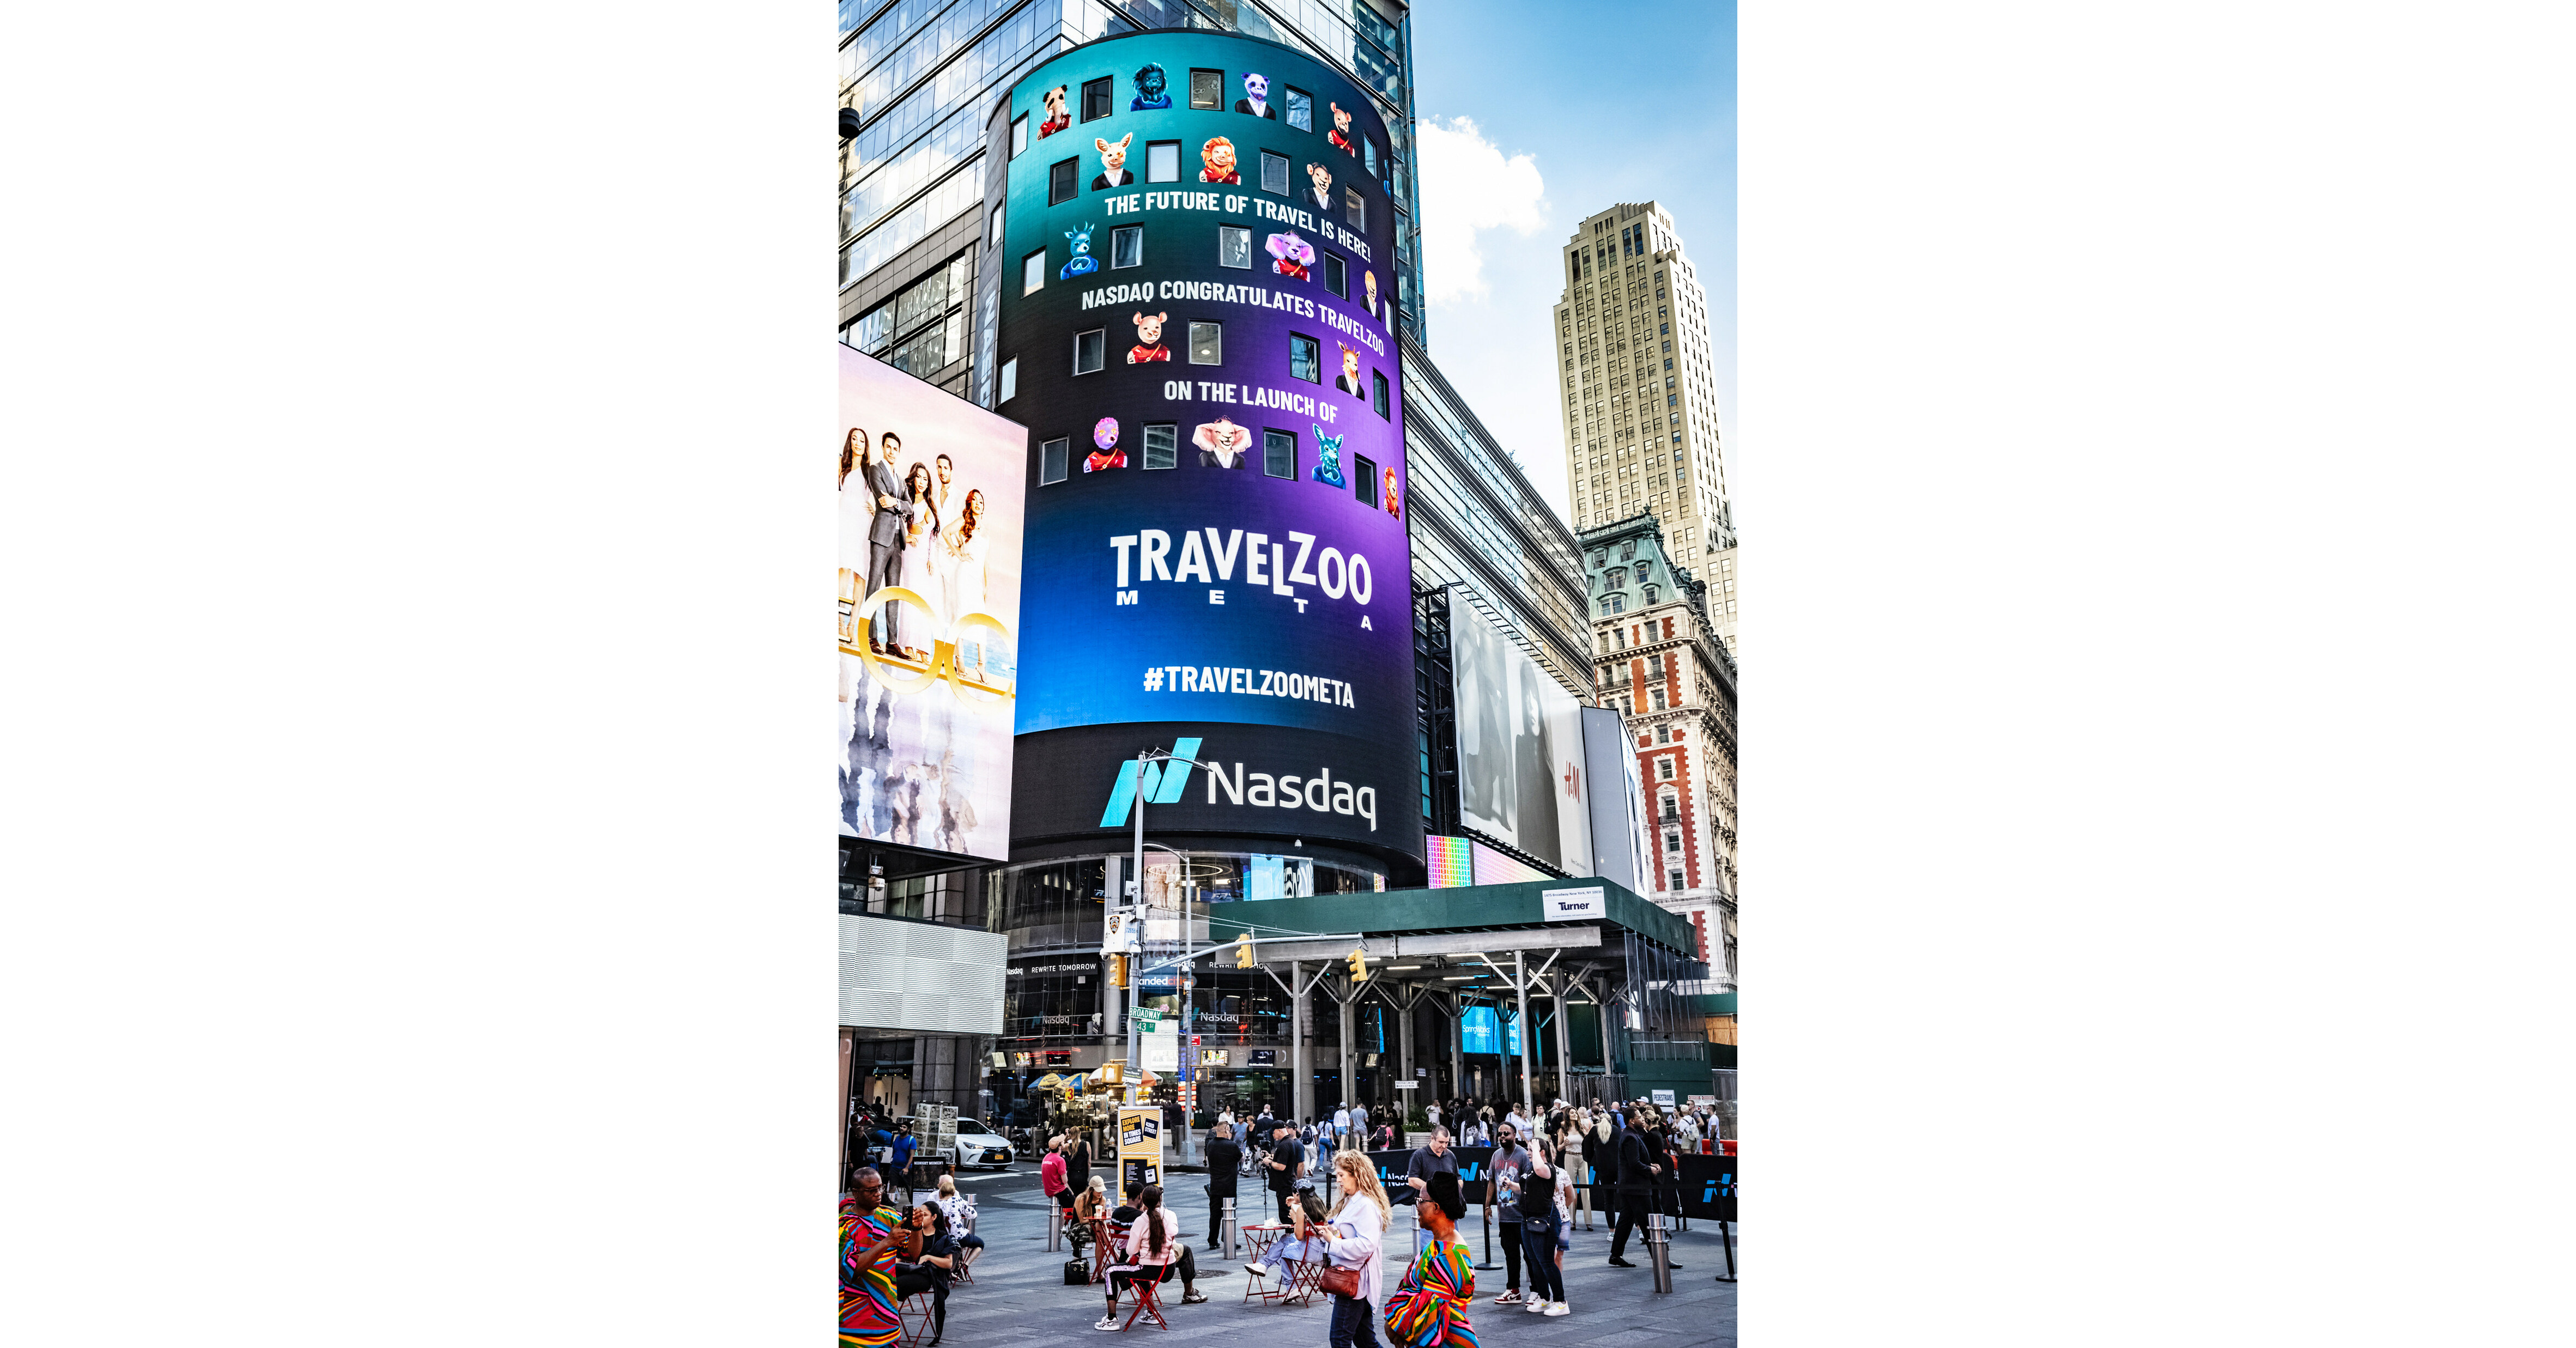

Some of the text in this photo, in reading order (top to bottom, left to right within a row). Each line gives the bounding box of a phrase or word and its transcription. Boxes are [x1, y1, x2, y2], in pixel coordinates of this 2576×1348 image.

[1105, 192, 1371, 264] THE FUTURE OF TRAVEL IS HERE!
[1082, 281, 1384, 357] NASDAQ CONGRATULATES TRAVELZOO
[979, 289, 996, 409] NASD
[1165, 380, 1338, 424] ON THE LAUNCH OF
[1110, 527, 1372, 605] TRAVELZOO
[1143, 666, 1355, 709] #TRAVELZOOMETA
[1564, 760, 1580, 804] H&M
[1207, 761, 1376, 832] Nasdaq
[1558, 902, 1590, 911] Turner
[1007, 967, 1023, 975] Nasdaq
[1058, 963, 1096, 971] TOMORROW
[1129, 1007, 1161, 1020] BROADWAY
[1200, 1012, 1239, 1024] Nasdaq
[1042, 1014, 1070, 1025] Nasdaq
[1137, 1022, 1147, 1031] 43
[1462, 1024, 1490, 1034] SpringWorks
[1122, 1116, 1141, 1126] EXPLORE
[1123, 1124, 1135, 1132] MORE
[1128, 1128, 1142, 1138] TIMES
[1144, 1126, 1156, 1135] STREET
[1124, 1135, 1142, 1145] SQUARE
